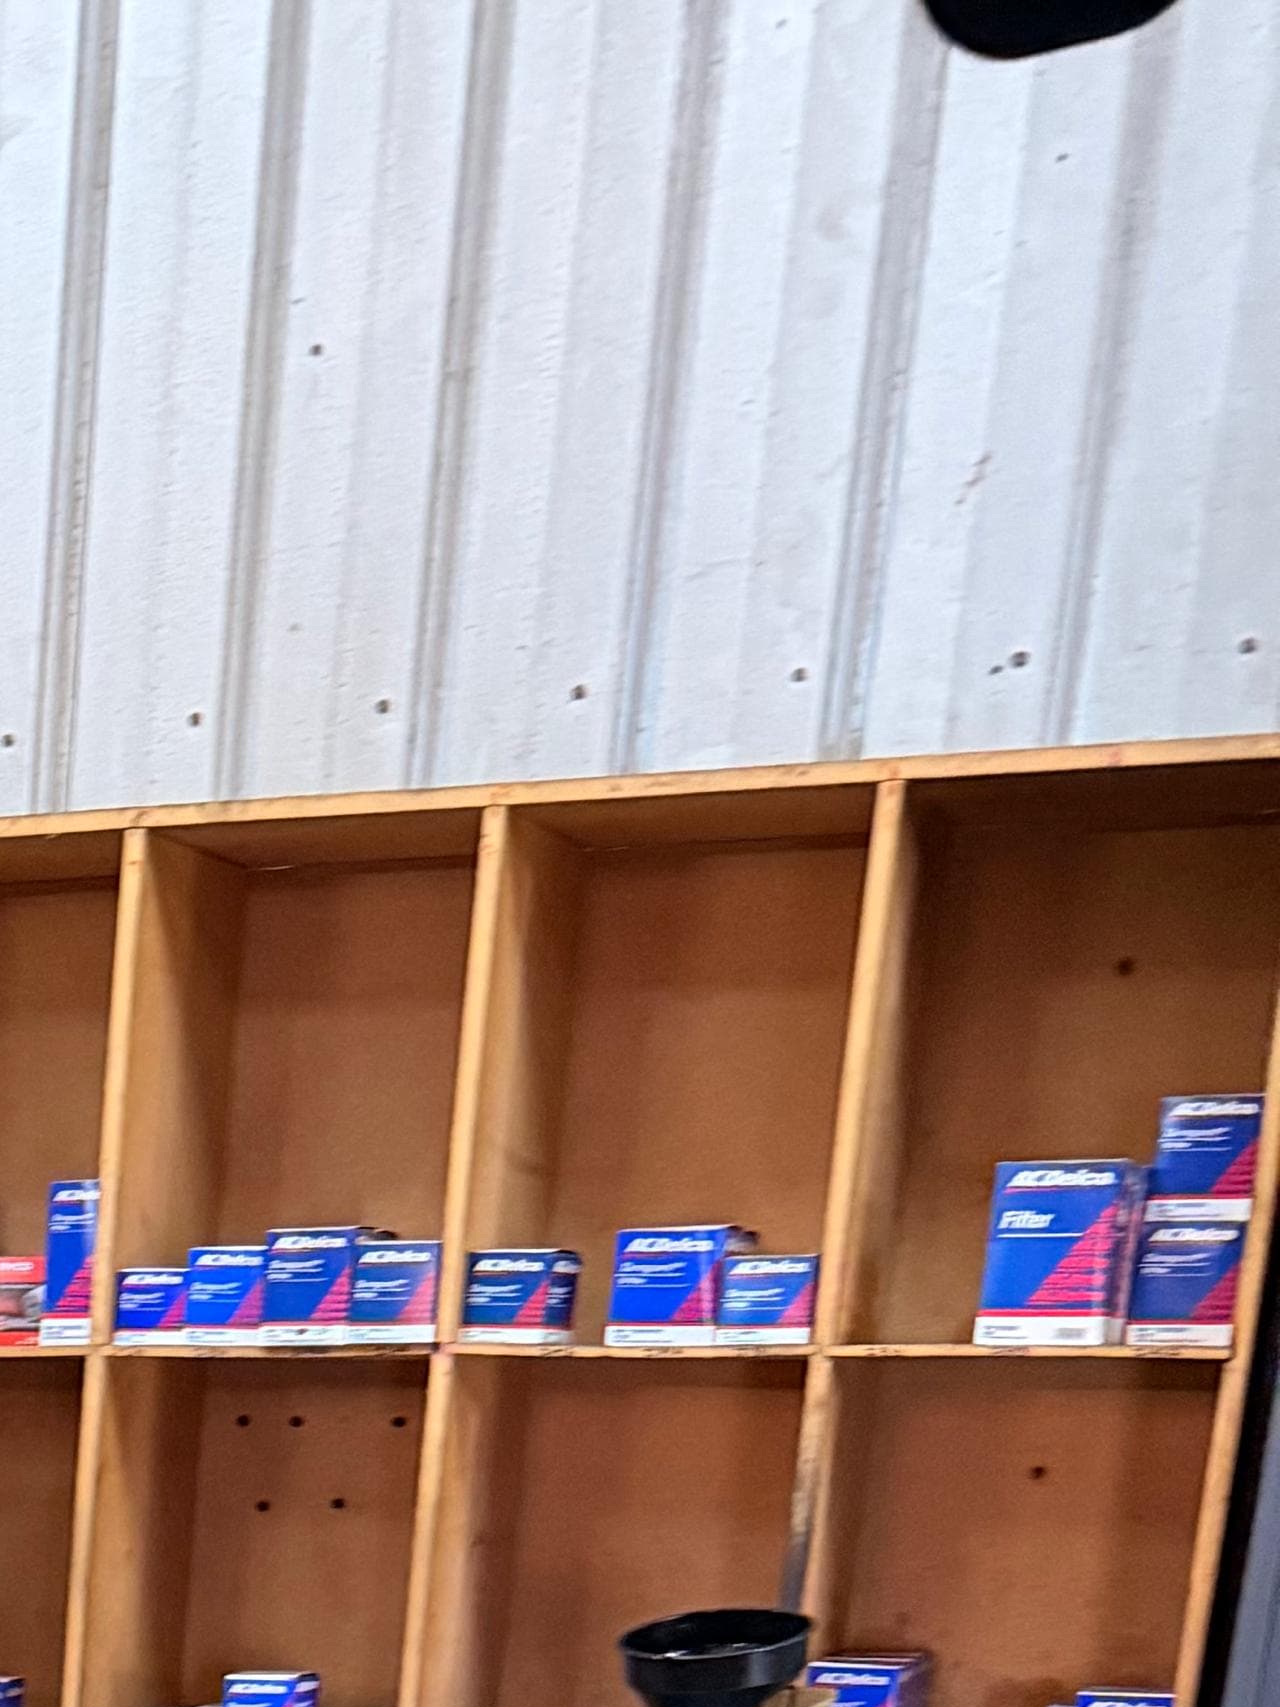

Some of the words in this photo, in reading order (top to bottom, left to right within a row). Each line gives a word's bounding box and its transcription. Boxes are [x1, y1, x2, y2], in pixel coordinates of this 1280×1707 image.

[1006, 1169, 1118, 1188] ACDelco
[997, 1210, 1055, 1229] Filter
[270, 1236, 348, 1250] ACDelco
[624, 1238, 715, 1253] ACDelco
[358, 1250, 432, 1264] ACDelco
